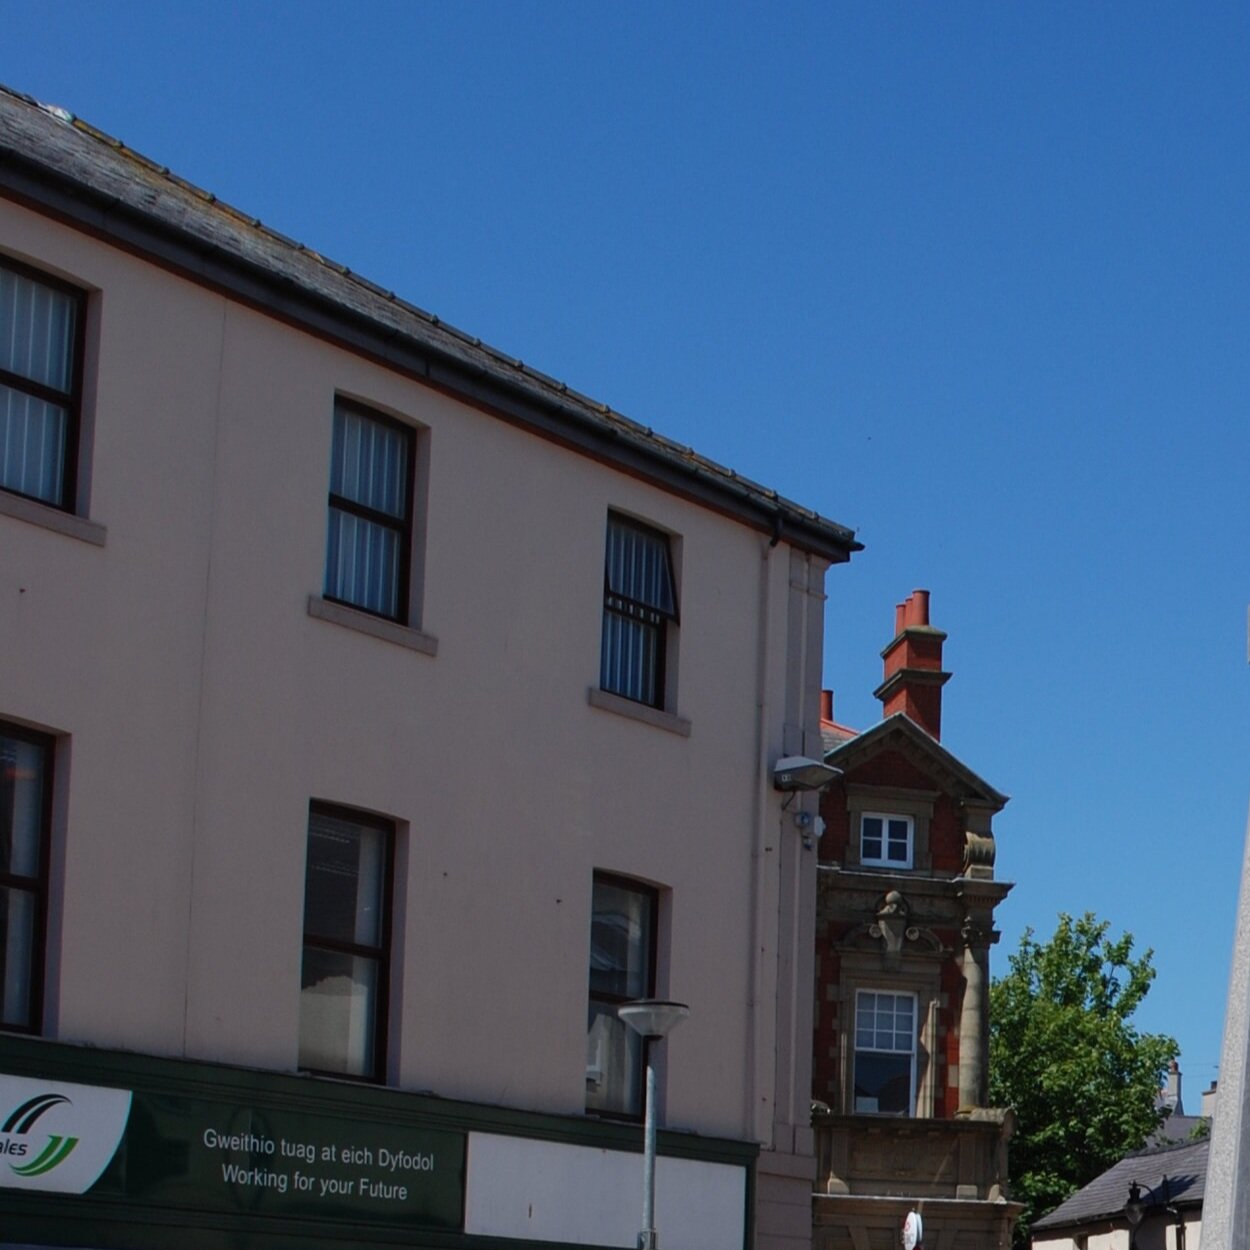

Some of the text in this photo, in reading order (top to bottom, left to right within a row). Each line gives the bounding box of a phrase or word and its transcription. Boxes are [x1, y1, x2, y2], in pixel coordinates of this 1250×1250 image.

[203, 1128, 434, 1172] Gweithio tuag at eich Dyfodol
[222, 1163, 408, 1200] Working for your Future
